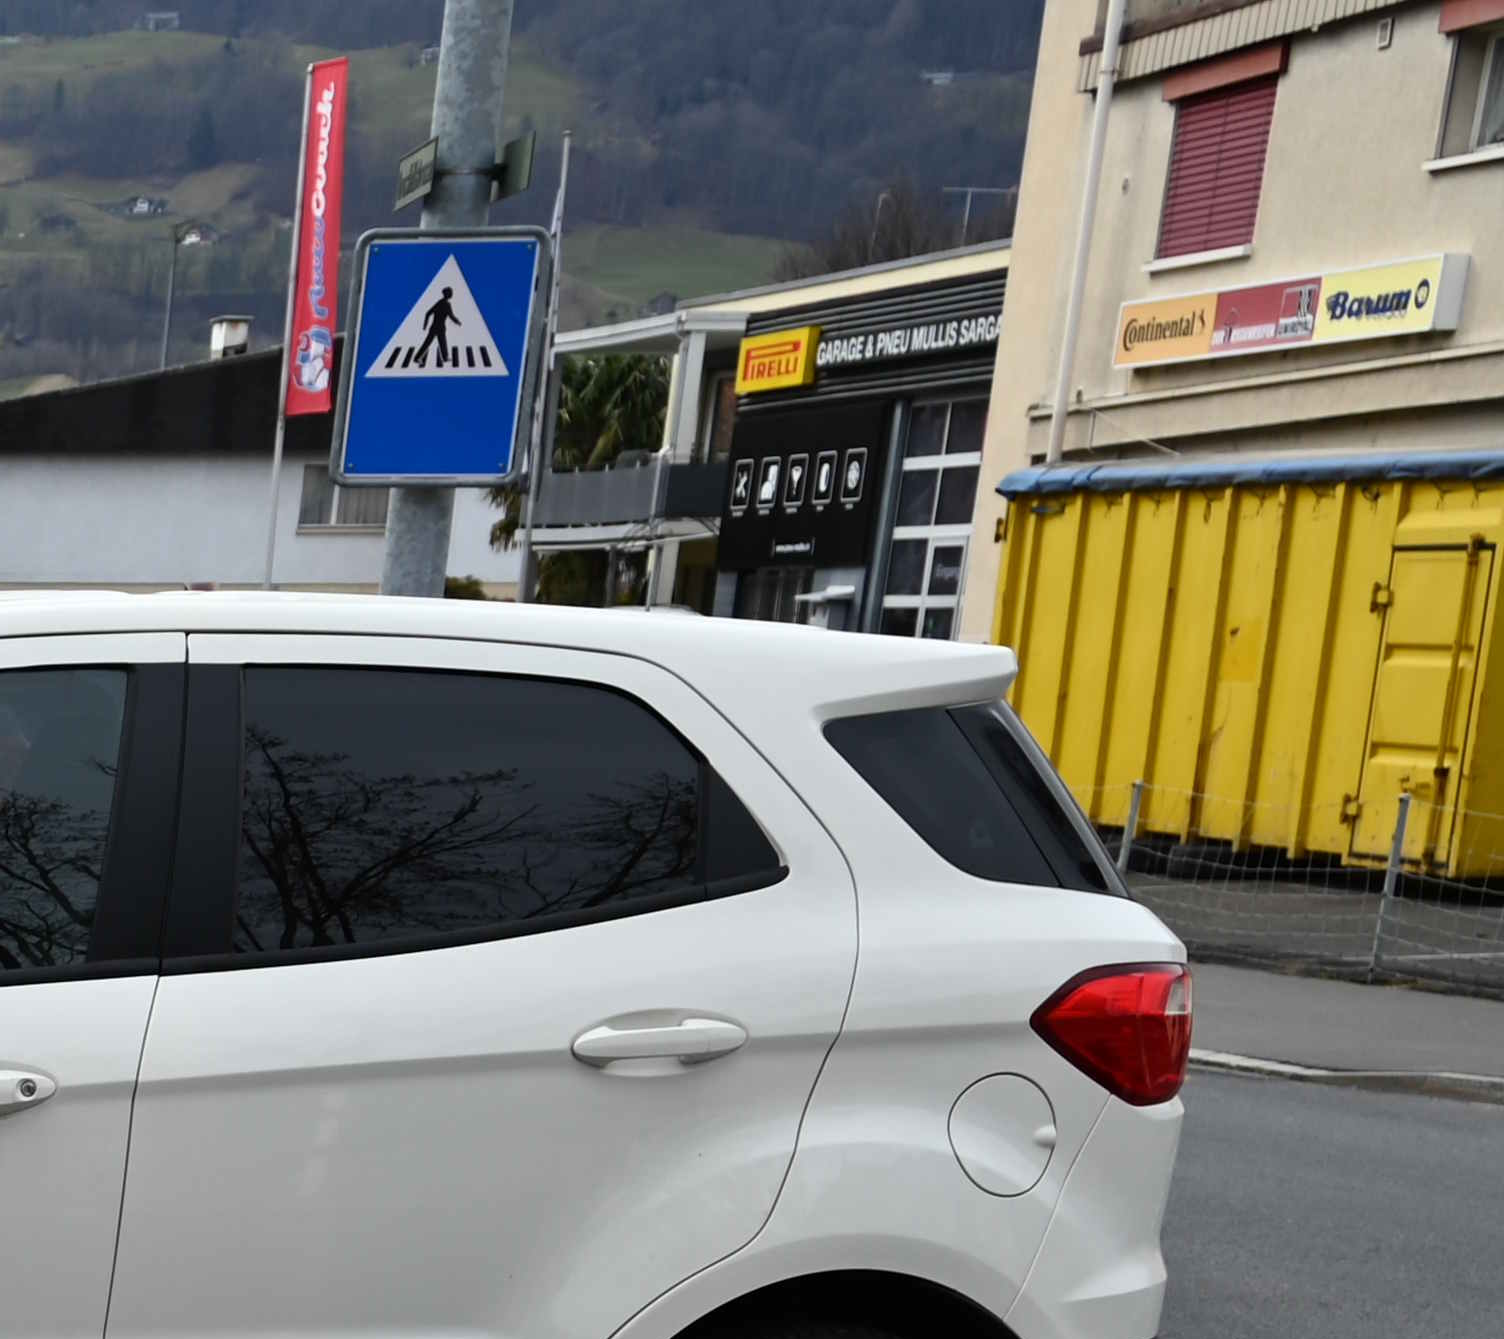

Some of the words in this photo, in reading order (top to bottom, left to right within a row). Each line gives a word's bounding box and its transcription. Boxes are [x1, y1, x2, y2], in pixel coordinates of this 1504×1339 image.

[1329, 288, 1412, 321] Barum
[816, 335, 865, 366] GARAGE
[864, 334, 874, 358] &
[875, 328, 910, 357] PNEU
[911, 320, 958, 351] MULLIS
[1122, 310, 1196, 352] Continental
[742, 340, 802, 382] PIRELLI
